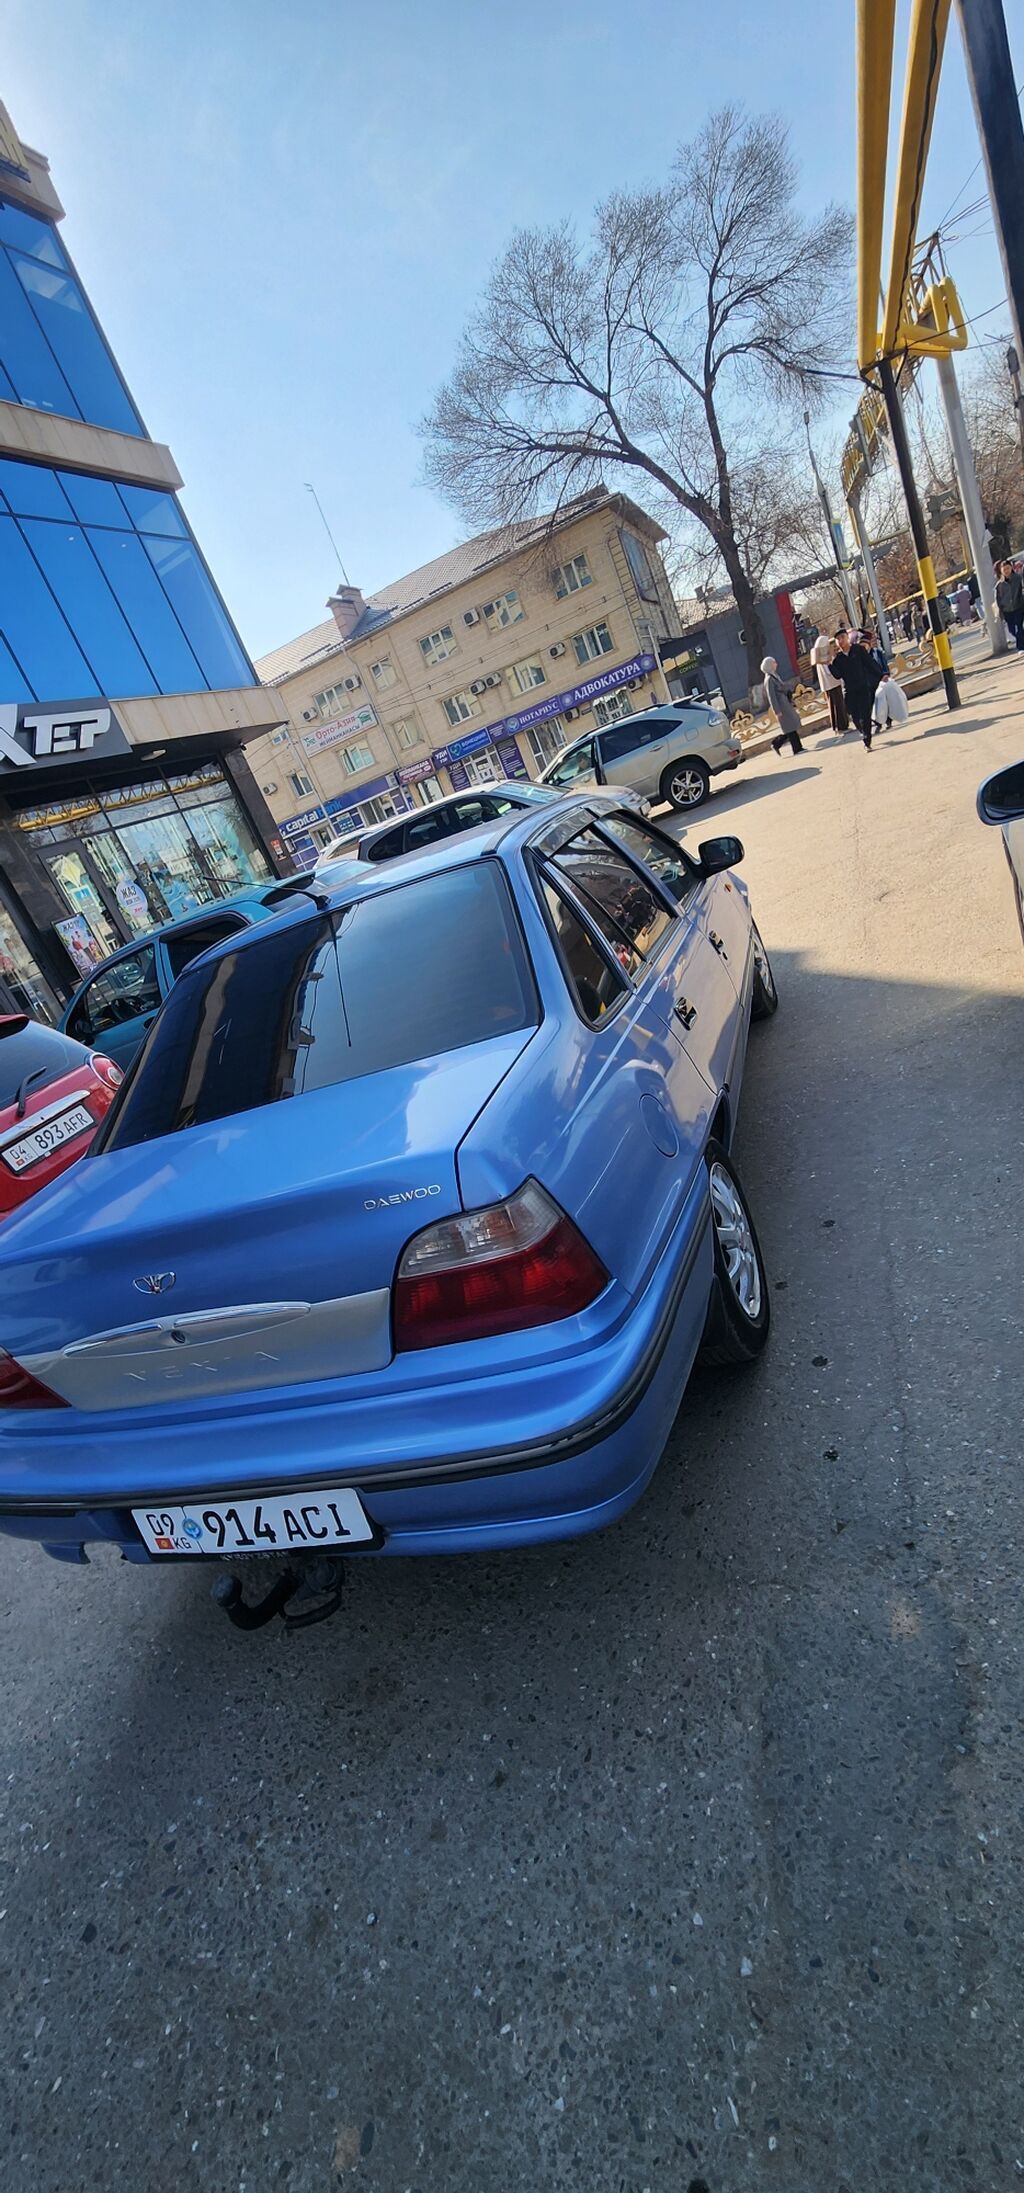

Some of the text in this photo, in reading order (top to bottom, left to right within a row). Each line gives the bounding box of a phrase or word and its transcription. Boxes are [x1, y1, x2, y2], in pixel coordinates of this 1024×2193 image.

[574, 661, 641, 700] АДВОКАТУРА
[519, 701, 559, 725] НОТАРИУС
[315, 716, 356, 740] Орто-Азия
[285, 810, 319, 832] capital
[34, 1112, 88, 1150] 893 AFR
[9, 1145, 27, 1160] 04
[363, 1184, 441, 1210] DAEWOO
[145, 1503, 352, 1548] 09 914 ACI
[173, 1536, 193, 1550] KG
